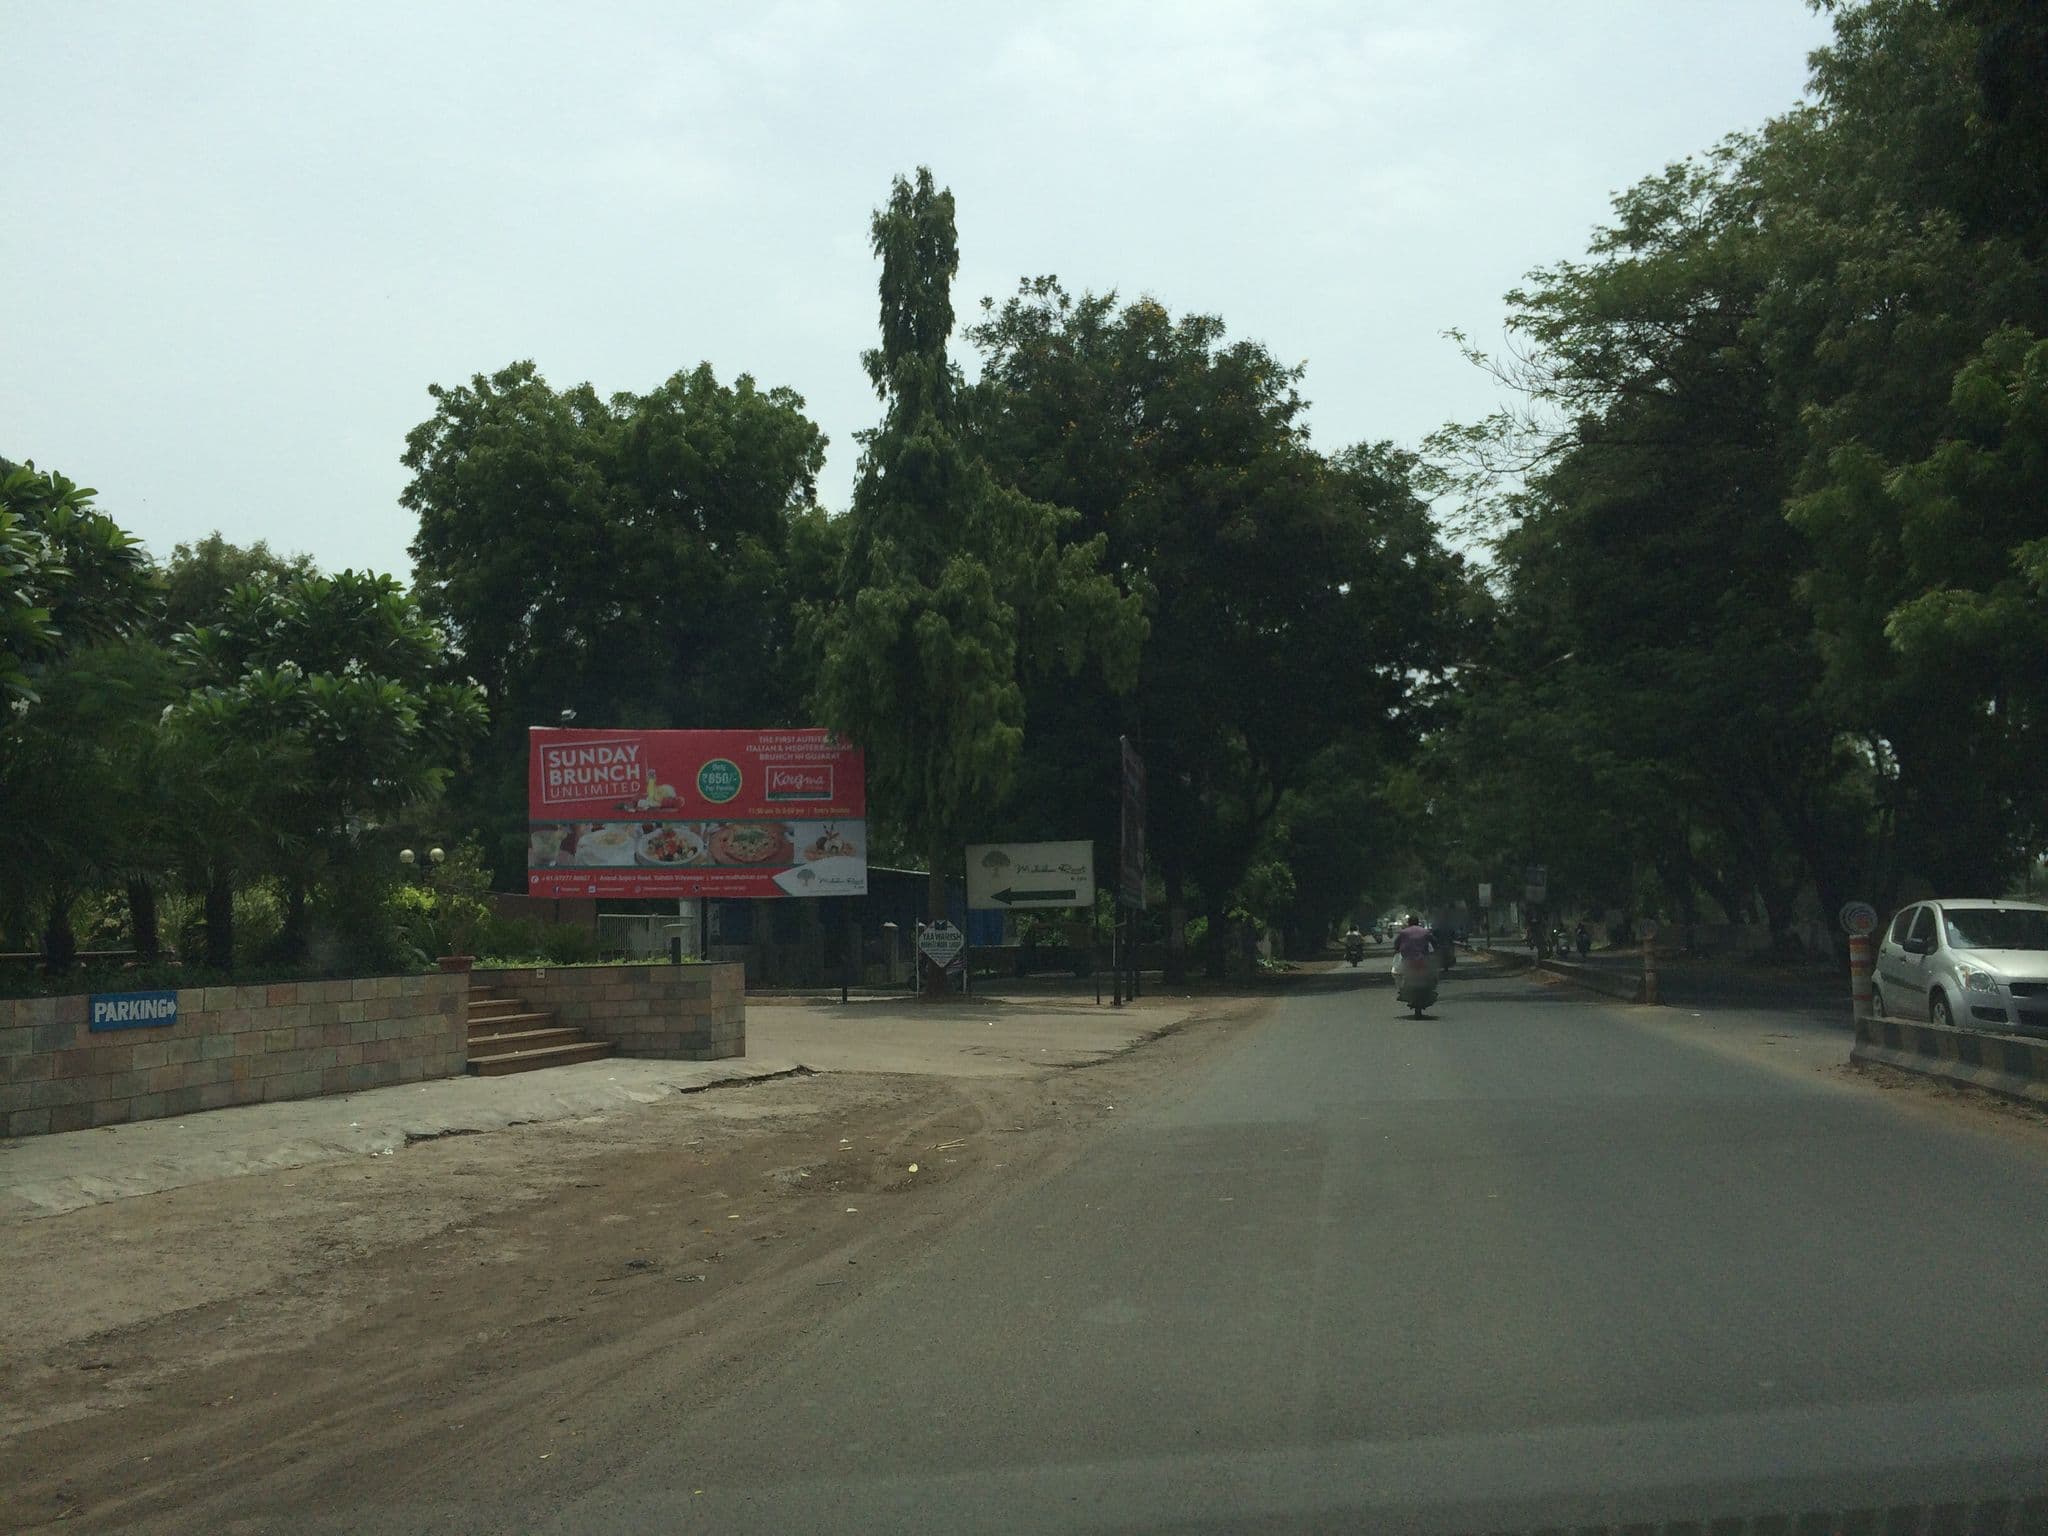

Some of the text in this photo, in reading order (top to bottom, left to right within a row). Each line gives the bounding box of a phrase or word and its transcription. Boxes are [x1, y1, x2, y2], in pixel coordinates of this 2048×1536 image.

[548, 744, 640, 768] SUNDAY
[759, 752, 794, 761] BRUNCH
[549, 763, 641, 786] BRUNCH
[550, 781, 641, 799] UNLIMITED
[94, 998, 167, 1023] PARKING
